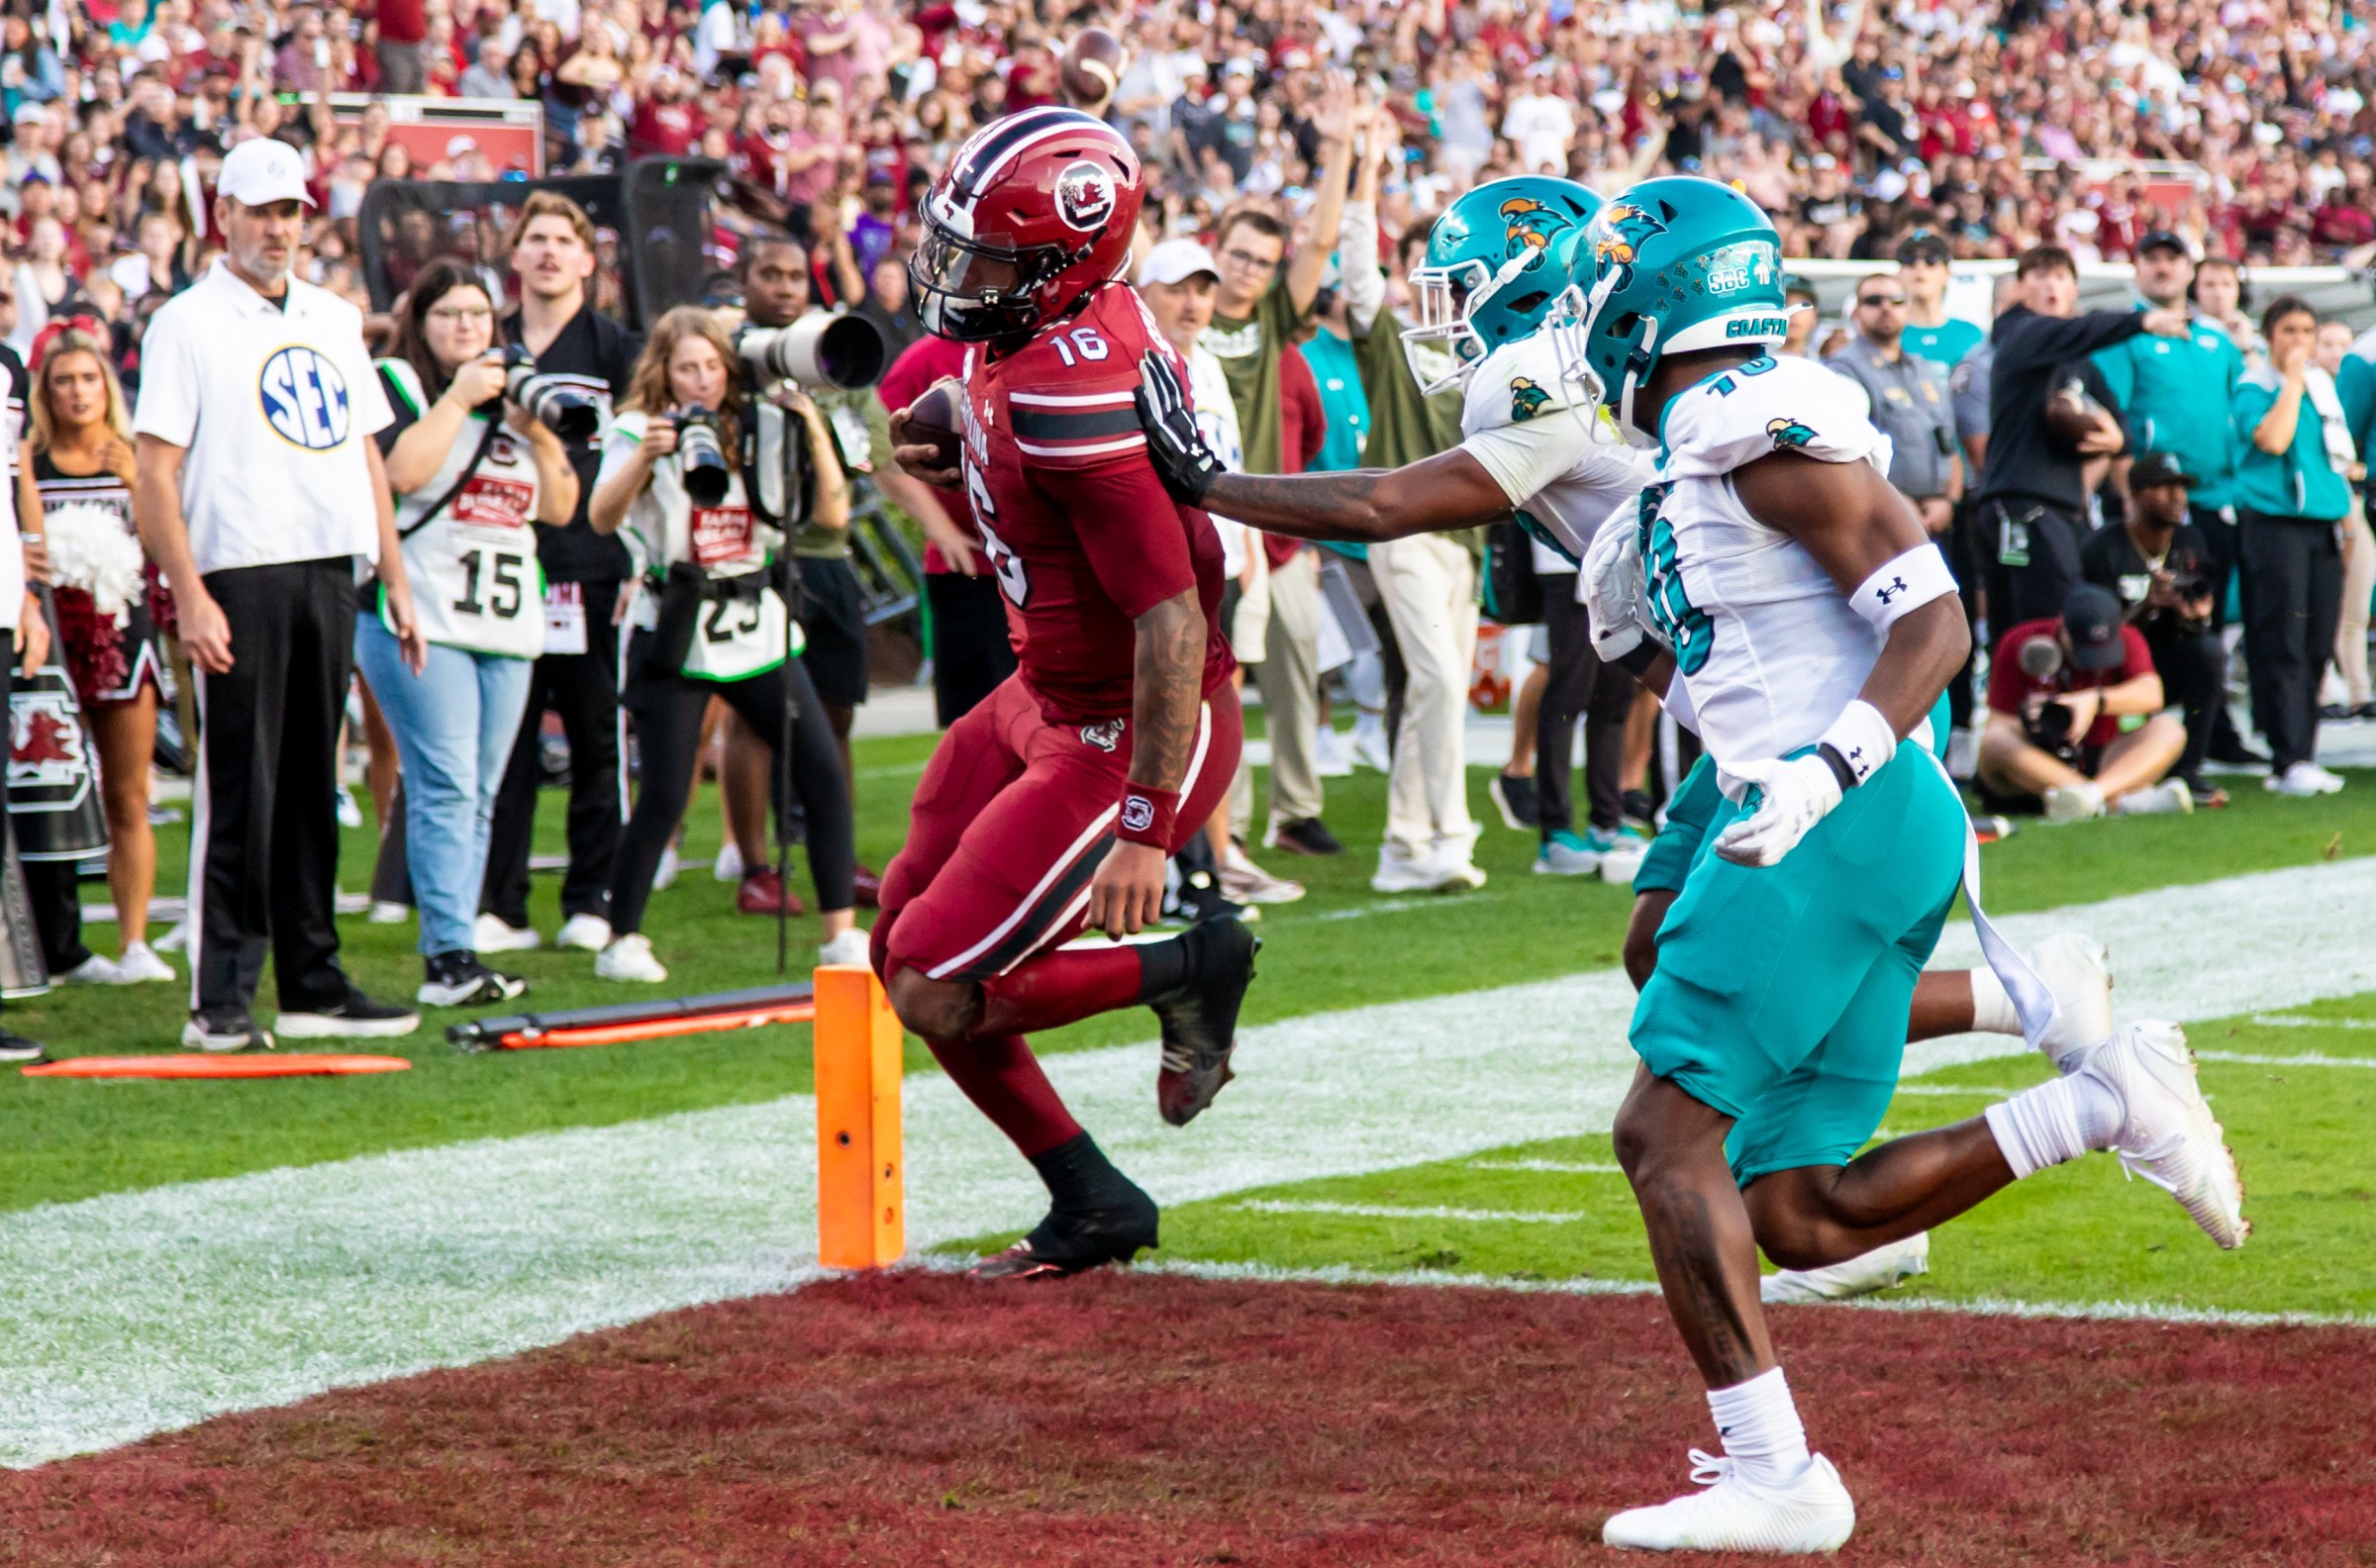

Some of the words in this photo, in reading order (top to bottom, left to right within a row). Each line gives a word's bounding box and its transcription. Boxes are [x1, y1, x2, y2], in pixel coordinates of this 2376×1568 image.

[1049, 327, 1110, 367] 16
[259, 347, 348, 449] SEC
[453, 549, 523, 619] 15
